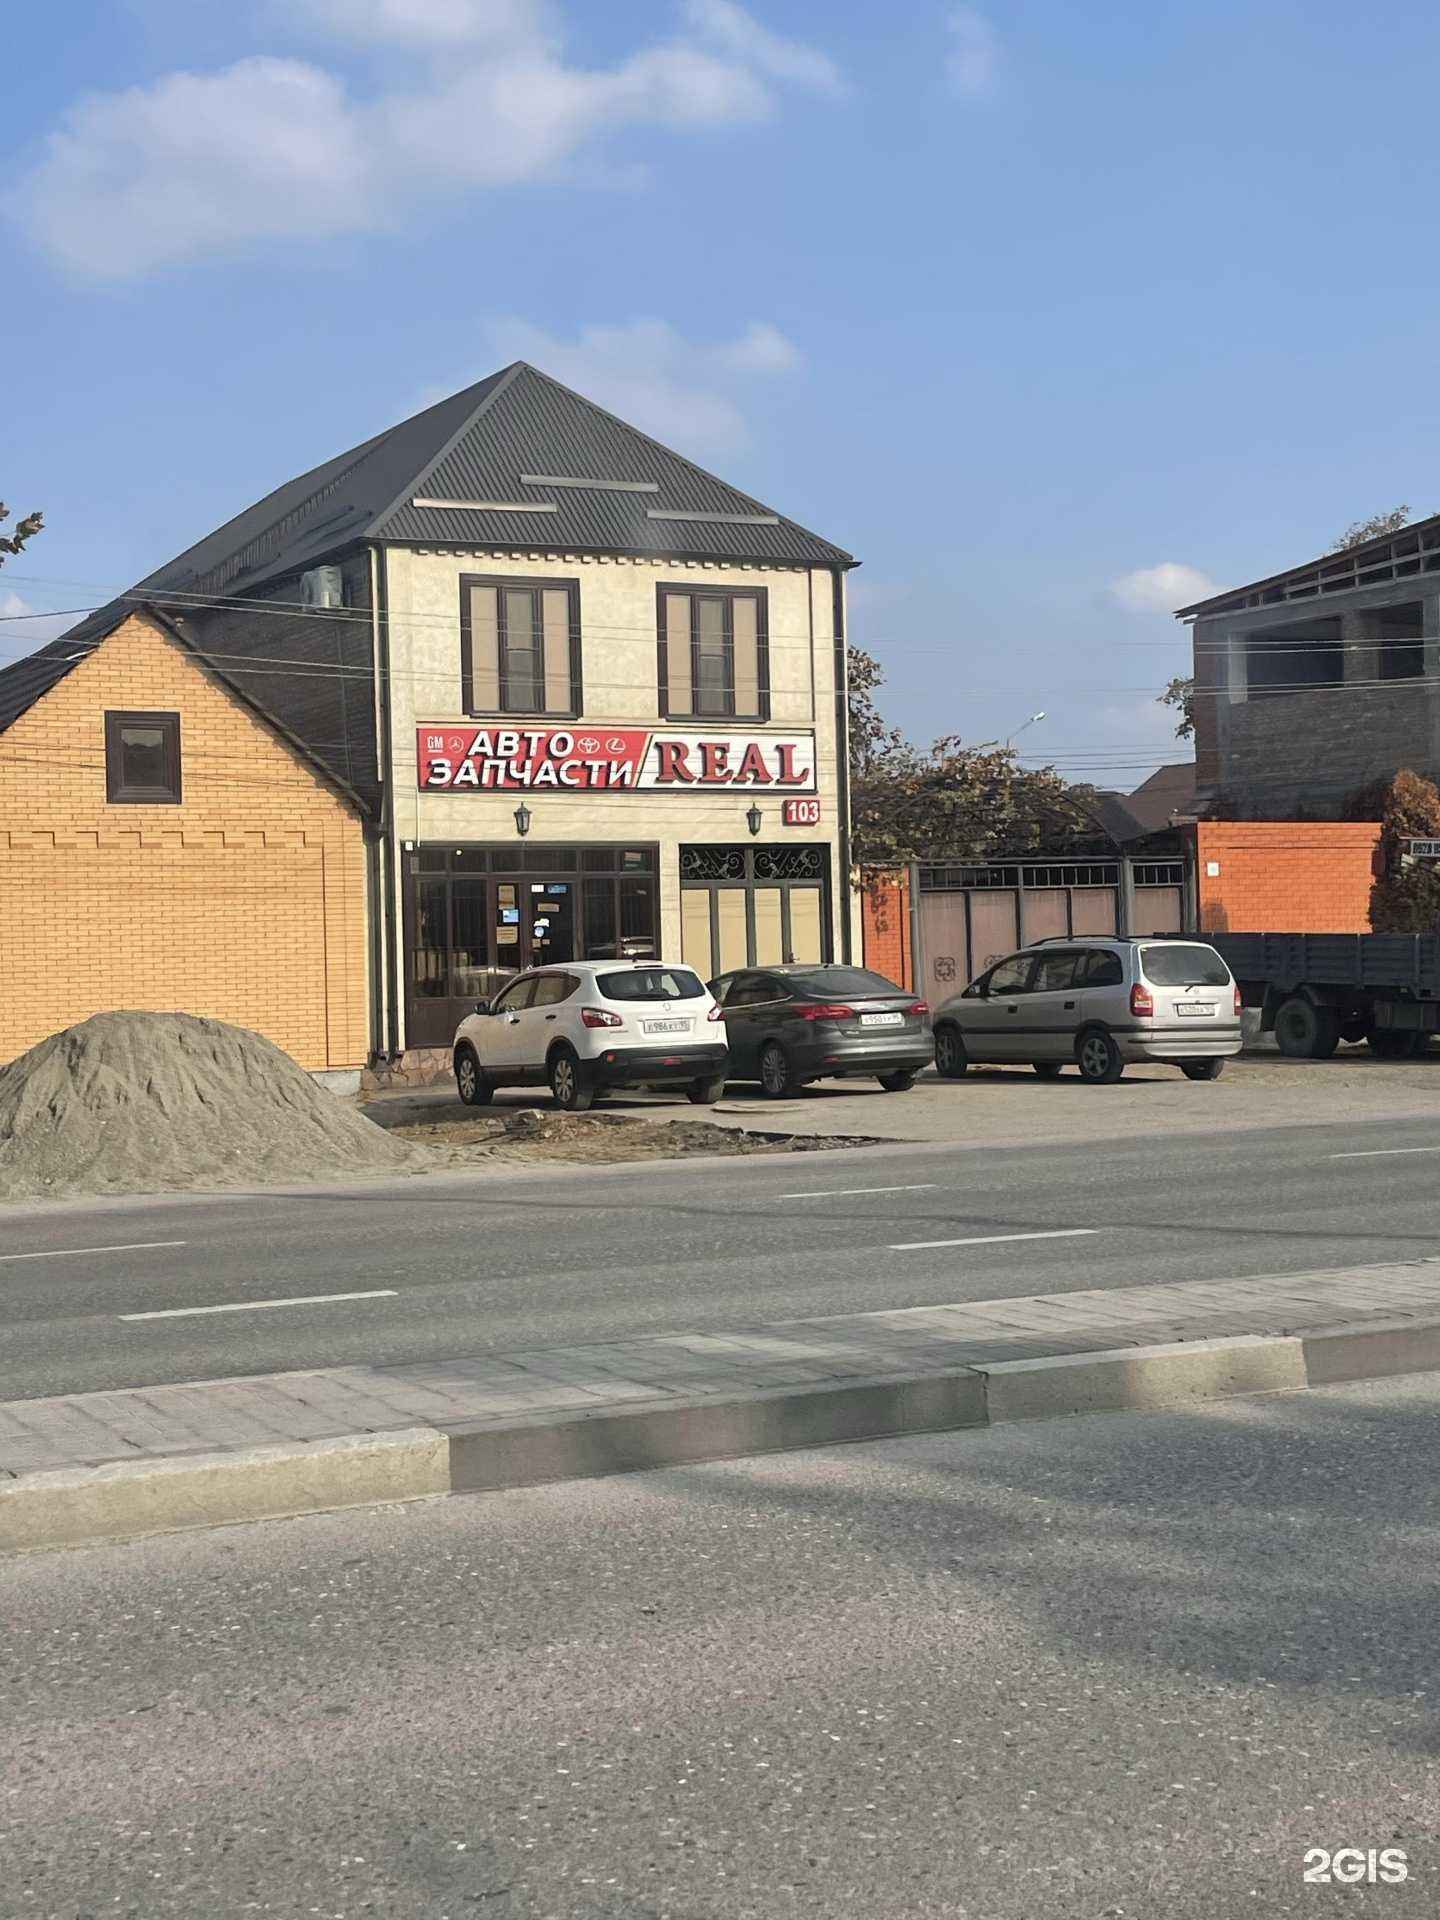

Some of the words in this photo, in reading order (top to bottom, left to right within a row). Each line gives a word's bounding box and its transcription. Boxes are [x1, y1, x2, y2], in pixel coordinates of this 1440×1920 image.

[427, 735, 443, 752] GM
[467, 730, 575, 758] АВТО
[427, 758, 634, 786] ЗАПЧАСТИ
[654, 741, 810, 785] REAL
[788, 801, 819, 823] 103
